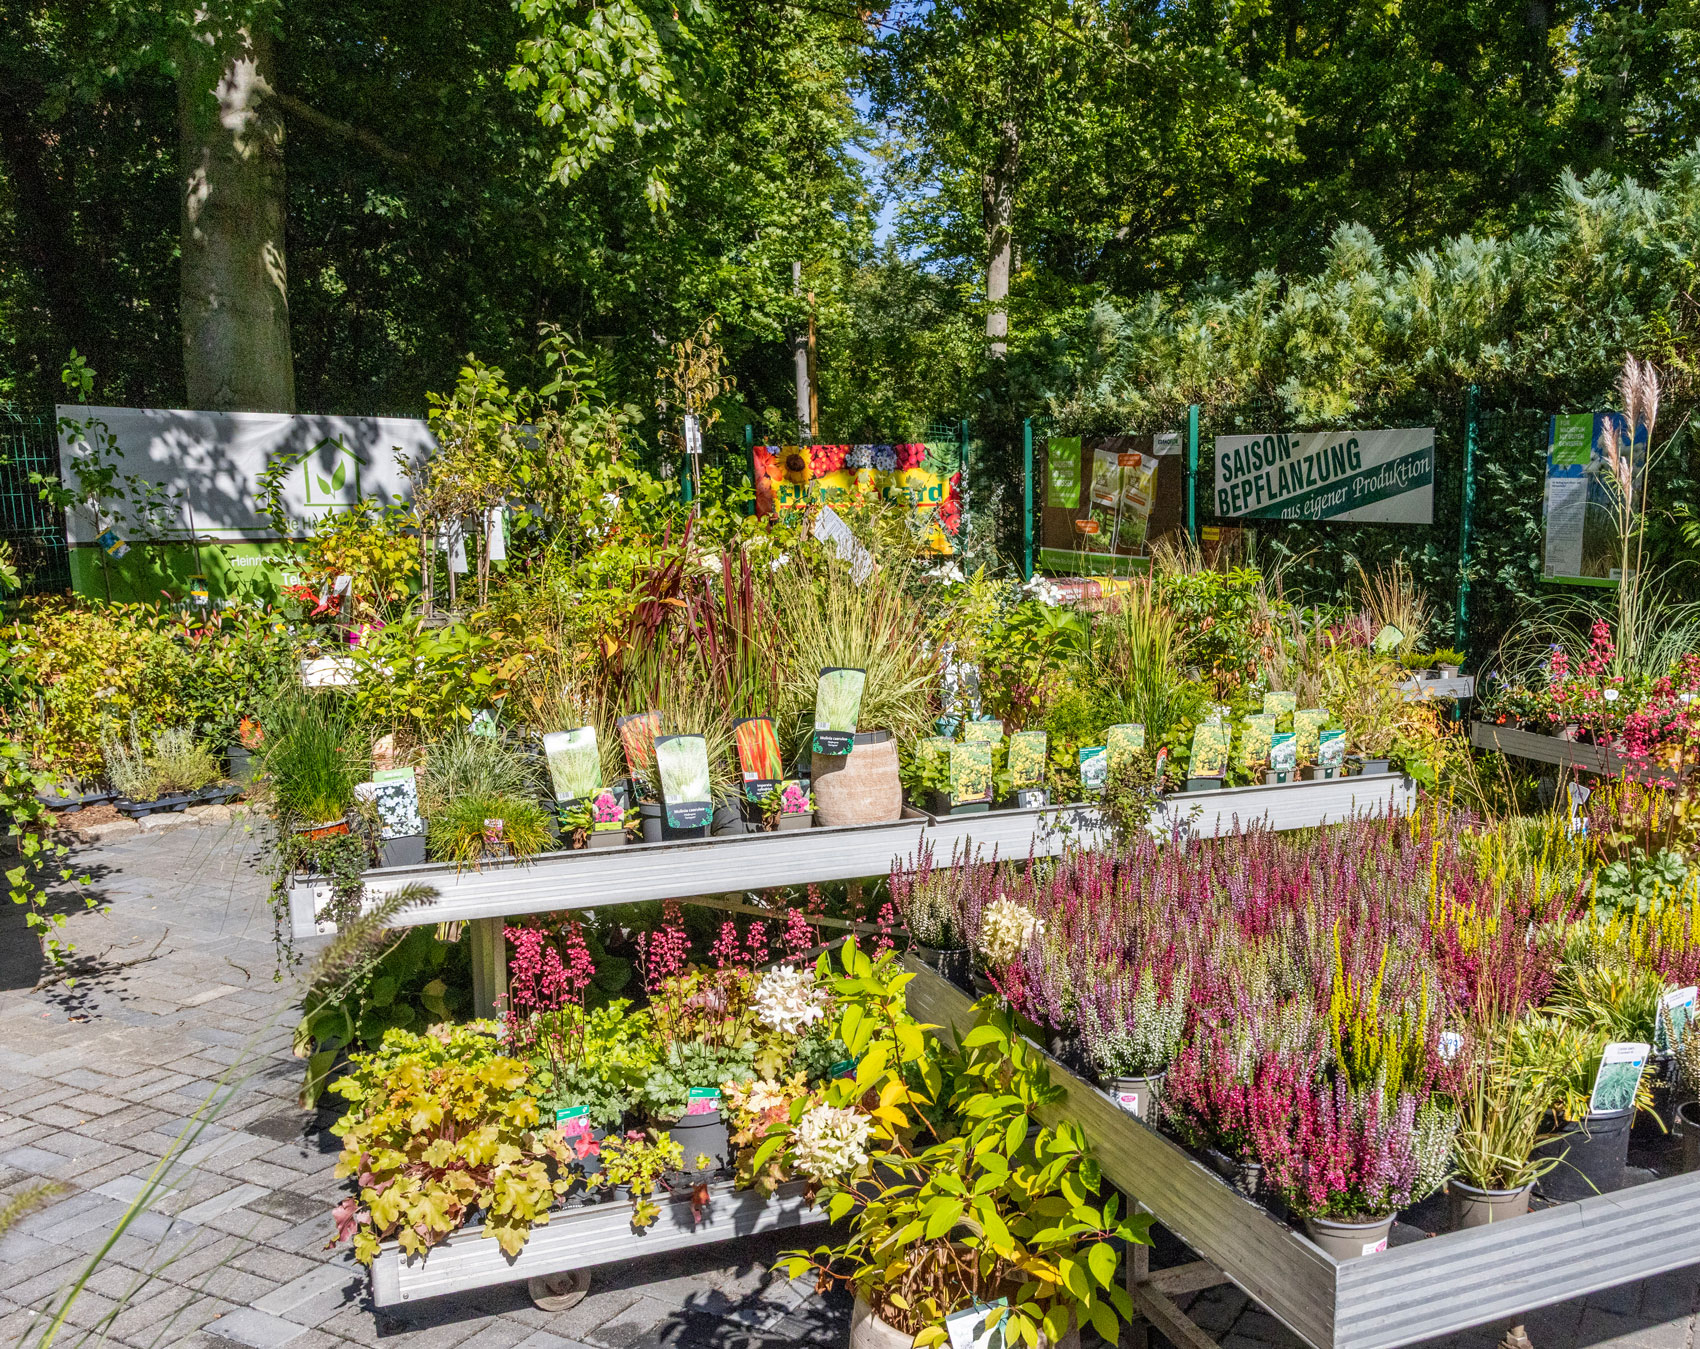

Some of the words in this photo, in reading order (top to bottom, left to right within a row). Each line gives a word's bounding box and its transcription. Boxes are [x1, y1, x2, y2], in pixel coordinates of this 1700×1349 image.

[1217, 438, 1362, 516] BEPFLANZUNG
[1221, 435, 1301, 483] SAISON-
[1281, 503, 1301, 519] aus
[1304, 486, 1348, 520] eigener
[1351, 457, 1431, 499] Produktion
